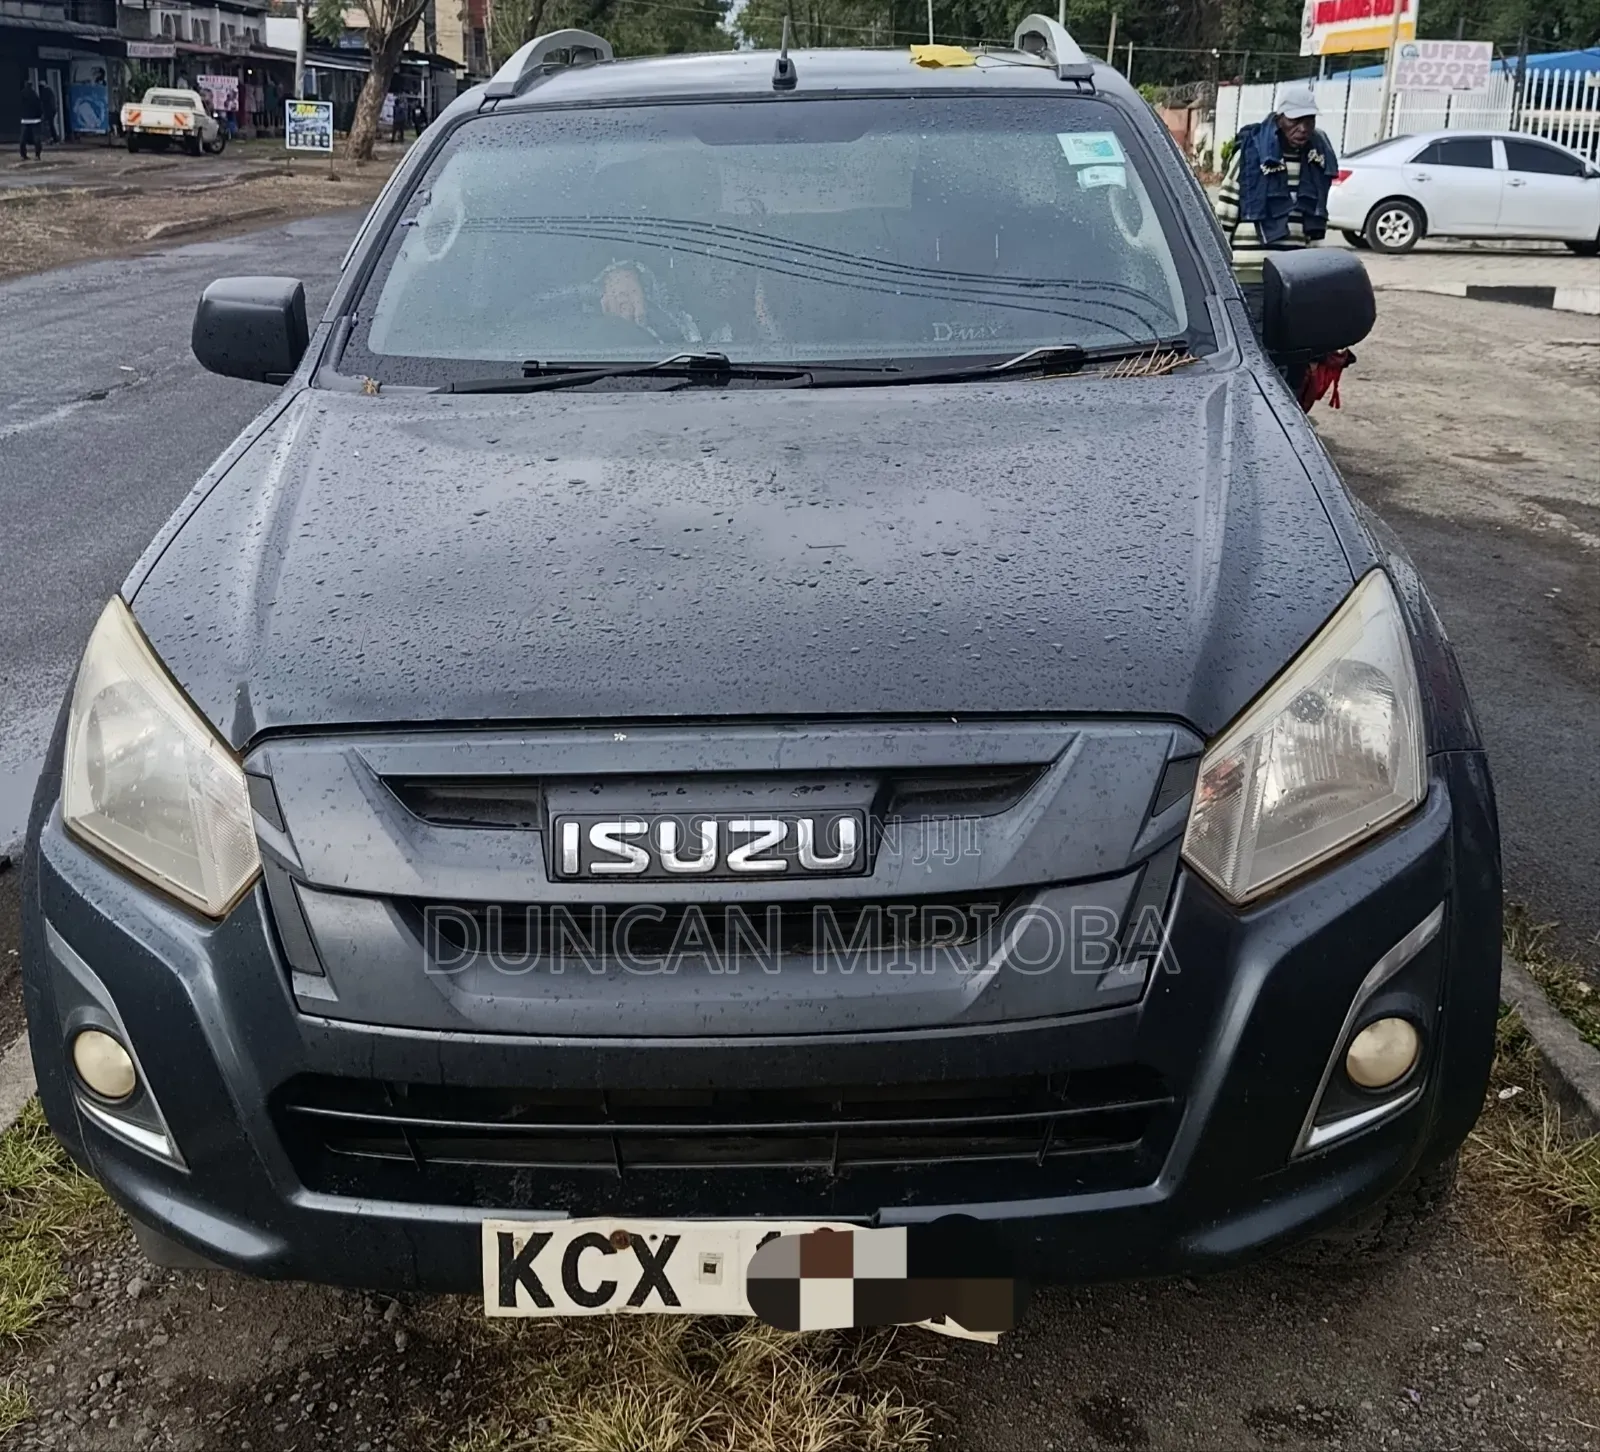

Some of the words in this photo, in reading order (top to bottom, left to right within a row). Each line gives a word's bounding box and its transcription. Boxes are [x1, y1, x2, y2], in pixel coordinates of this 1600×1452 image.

[1421, 43, 1488, 60] UFRA
[1397, 60, 1489, 76] MOTORS
[1394, 73, 1486, 88] BAZAAR
[562, 818, 857, 874] ISUZU
[497, 1231, 681, 1308] KCX
